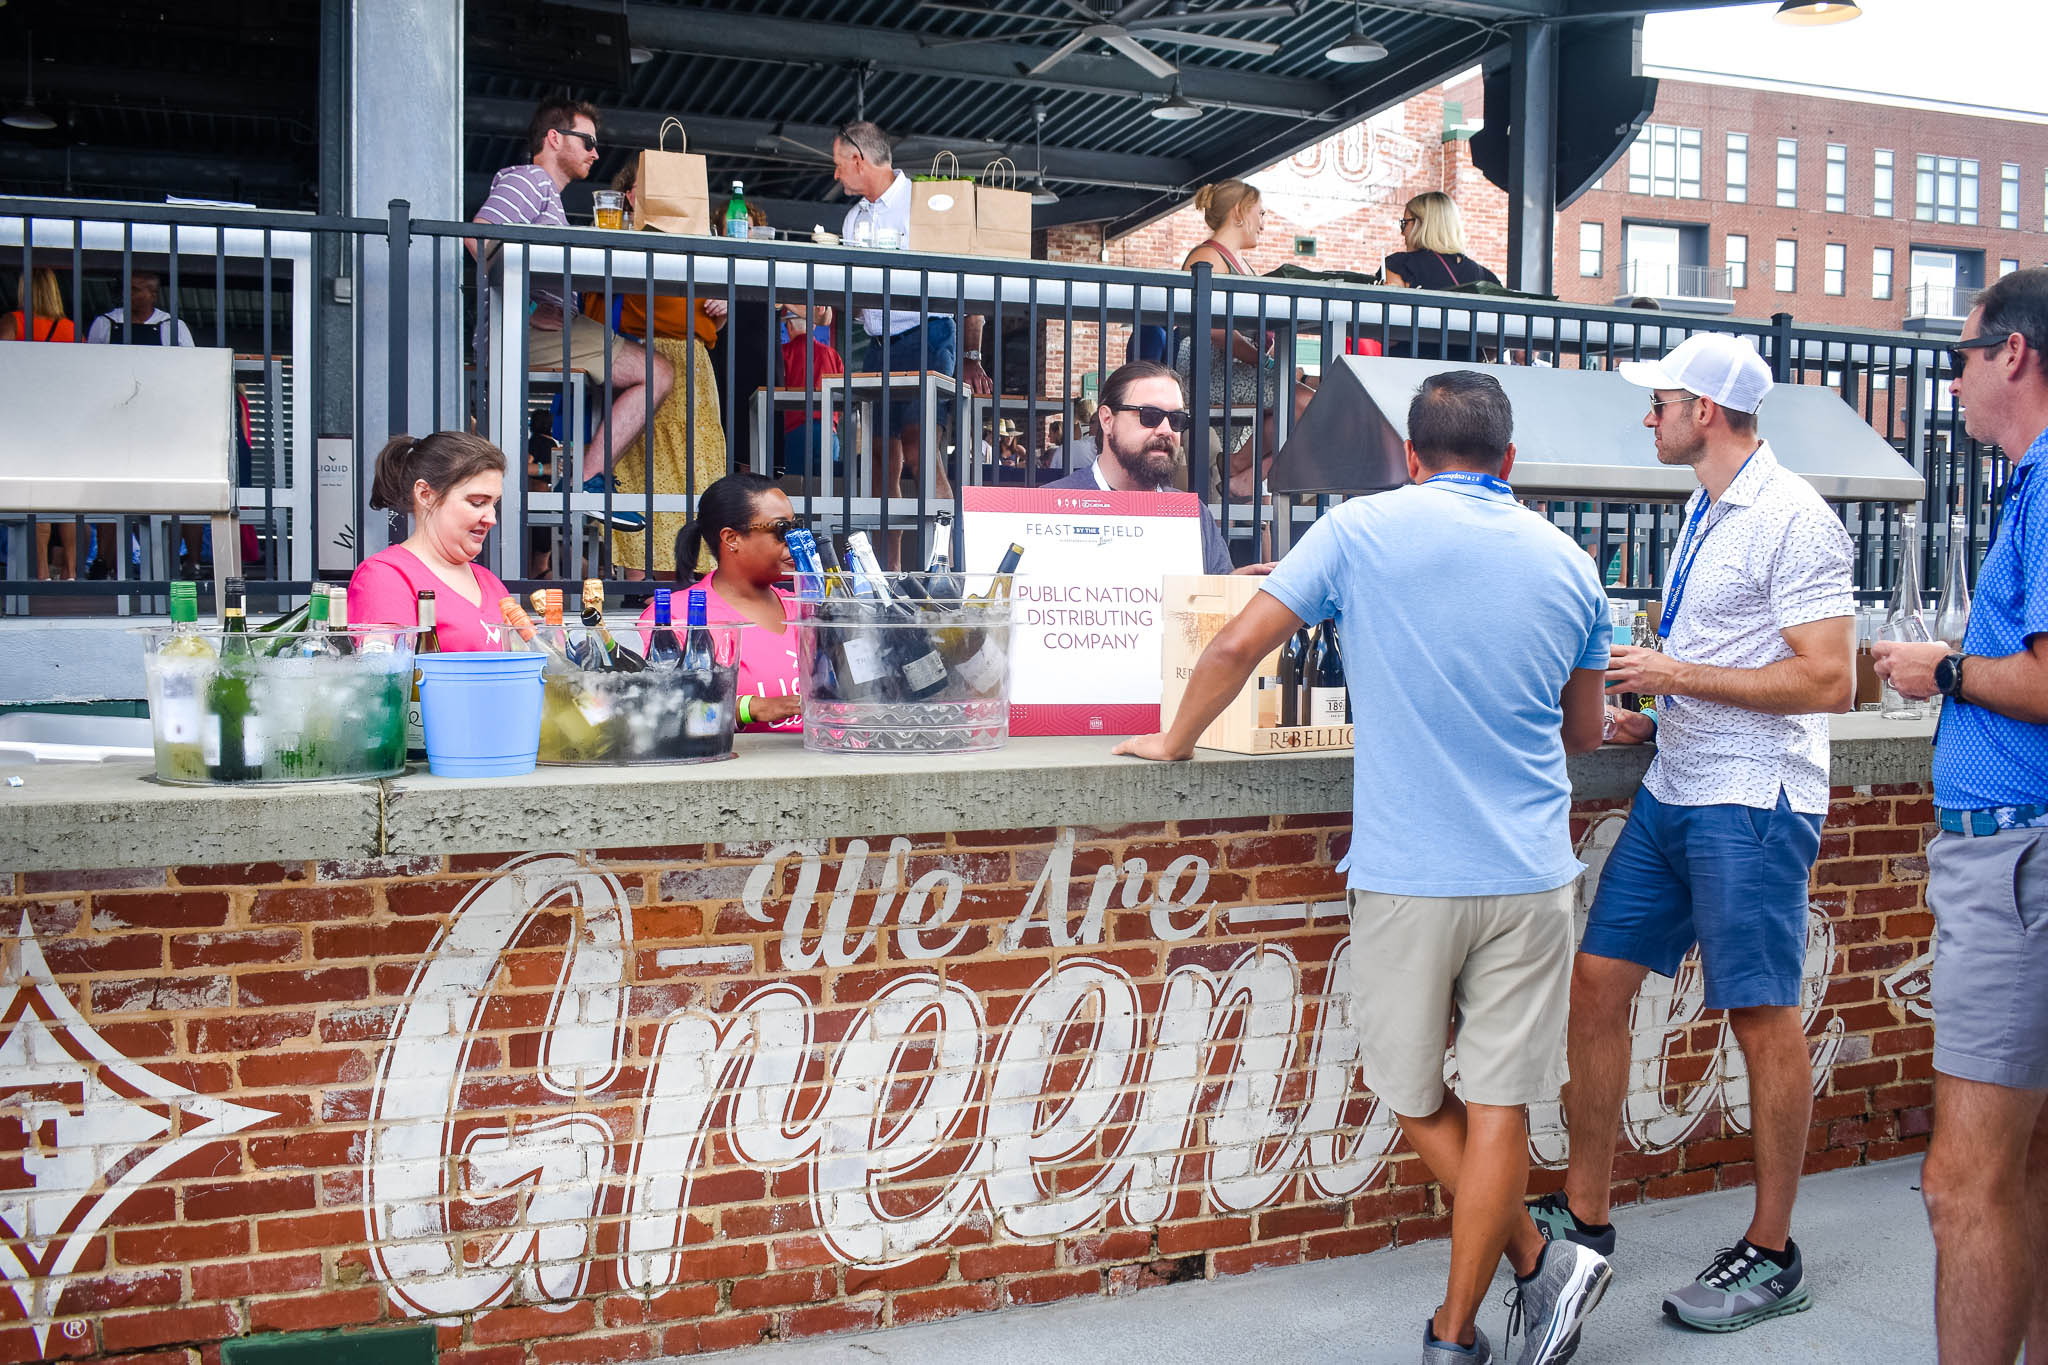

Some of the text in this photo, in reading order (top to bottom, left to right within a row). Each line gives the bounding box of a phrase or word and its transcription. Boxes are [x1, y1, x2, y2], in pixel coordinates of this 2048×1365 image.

[1026, 523, 1071, 536] FEAST
[1103, 525, 1144, 537] FIELD
[1018, 585, 1163, 603] PUBLIC NATION
[1027, 608, 1153, 626] DISTRIBUTING
[1043, 632, 1140, 650] COMPANY
[1327, 701, 1345, 711] 189
[742, 827, 1218, 971] We Are
